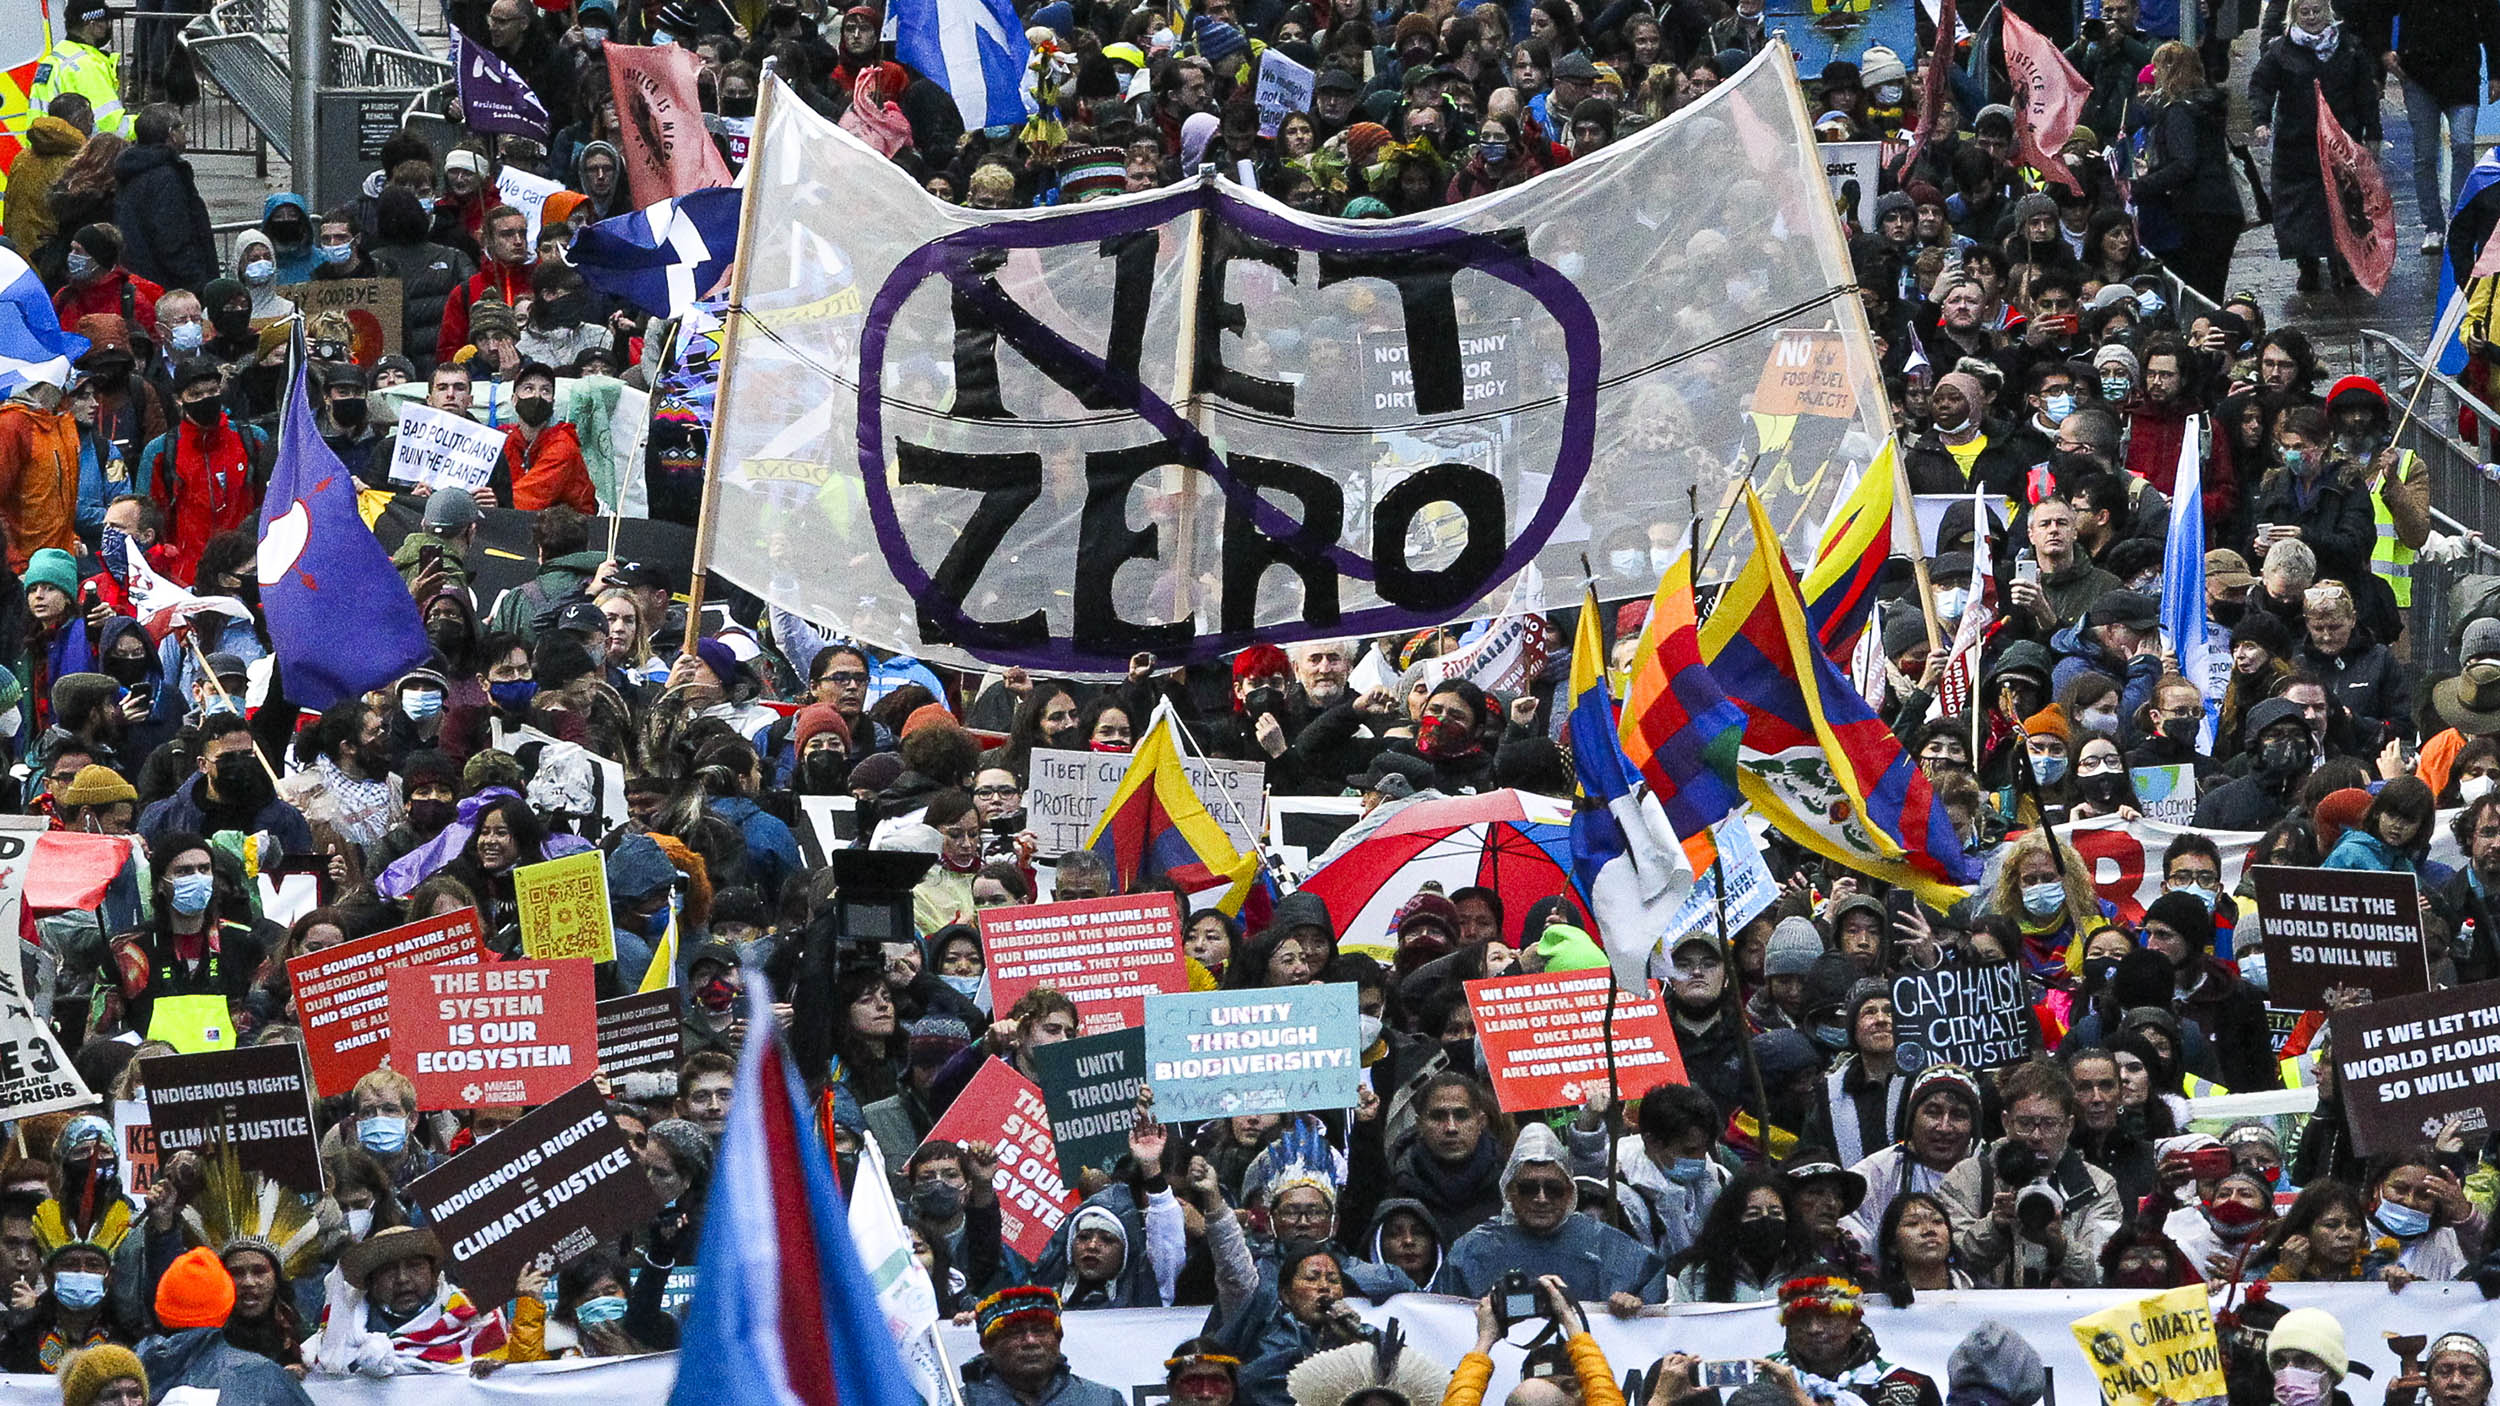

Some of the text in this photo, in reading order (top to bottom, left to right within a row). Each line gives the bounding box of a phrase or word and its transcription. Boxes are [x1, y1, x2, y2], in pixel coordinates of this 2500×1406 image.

[2011, 50, 2045, 114] JUSTICE IS
[656, 98, 671, 113] IS
[1826, 162, 1857, 178] SAKE,
[499, 176, 519, 196] We
[950, 212, 1530, 417] NET
[1460, 335, 1507, 356] ENNY
[1776, 335, 1812, 367] NO
[1375, 380, 1507, 410] DIRT ERGY
[402, 418, 498, 463] BAD POLITICIANS
[398, 445, 424, 466] RUIN
[441, 457, 489, 488] PLANET!
[895, 436, 1506, 652] ZERO
[1040, 757, 1087, 781] TIBET
[1033, 789, 1098, 818] PROTECT
[1050, 822, 1090, 850] IT
[2279, 892, 2398, 916] IF WE LET THE
[987, 906, 1171, 935] THE SOUNDS OF NATURE ARE
[2264, 917, 2419, 943] WORLD FLOURISH
[988, 921, 1174, 950] EMBEDDED IN THE WORDS OF
[296, 922, 474, 984] THE SOUNDS OF NATURE ARE
[993, 936, 1176, 964] OUR INDIGENOUS BROTHERS
[2290, 945, 2398, 968] SO WILL WE!
[299, 936, 478, 999] EMBEDDED IN THE WORDS OF
[997, 951, 1176, 980] AND SISTERS. THEY SHOULD
[1058, 972, 1120, 988] ALLOWED
[1120, 970, 1140, 983] TO
[430, 968, 551, 995] THE BEST
[1066, 983, 1164, 1003] THEIRS SONGS.
[1480, 981, 1560, 1001] WE ARE ALL
[1893, 959, 2026, 1017] CAPITALISM
[304, 996, 334, 1014] OUR
[438, 994, 545, 1021] SYSTEM
[1211, 1002, 1293, 1027] UNITY
[1476, 990, 1636, 1017] TO THE EARTH. WE NED
[310, 1010, 340, 1029] AND
[350, 1016, 368, 1033] BE
[448, 1020, 538, 1047] IS OUR
[1484, 1016, 1529, 1033] LEARN
[1530, 1014, 1548, 1028] OF
[1551, 1011, 1580, 1026] OUR
[2362, 1029, 2383, 1050] IF
[2386, 1021, 2425, 1045] WE
[2428, 1013, 2465, 1037] LET
[333, 1032, 378, 1054] SHARE
[1187, 1026, 1319, 1053] THROUGH
[1533, 1024, 1619, 1045] ONCE AGAI.
[28, 1036, 60, 1074] 3
[415, 1043, 573, 1075] ECOSYSTEM
[1075, 1050, 1125, 1079] UNITY
[1155, 1047, 1353, 1081] BIODIVERSITY!
[1507, 1044, 1593, 1063] INDIGENOUS
[2343, 1034, 2500, 1081] WORLD FLOUR
[26, 1074, 52, 1086] LINE
[1501, 1065, 1530, 1079] ARE
[1530, 1062, 1561, 1077] OUR
[1561, 1058, 1595, 1074] BEST
[151, 1074, 301, 1106] INDIGENOUS RIGHTS
[1067, 1077, 1146, 1110] THROUGH
[2378, 1069, 2470, 1103] SO WILL
[239, 1116, 309, 1142] JUSTICE
[1053, 1107, 1141, 1143] BIODIVERS
[994, 1138, 1022, 1167] IS
[430, 1110, 609, 1224] INDIGENOUS RIGHTS
[452, 1146, 633, 1263] CLIMATE JUSTICE
[2165, 1344, 2218, 1381] NOW
